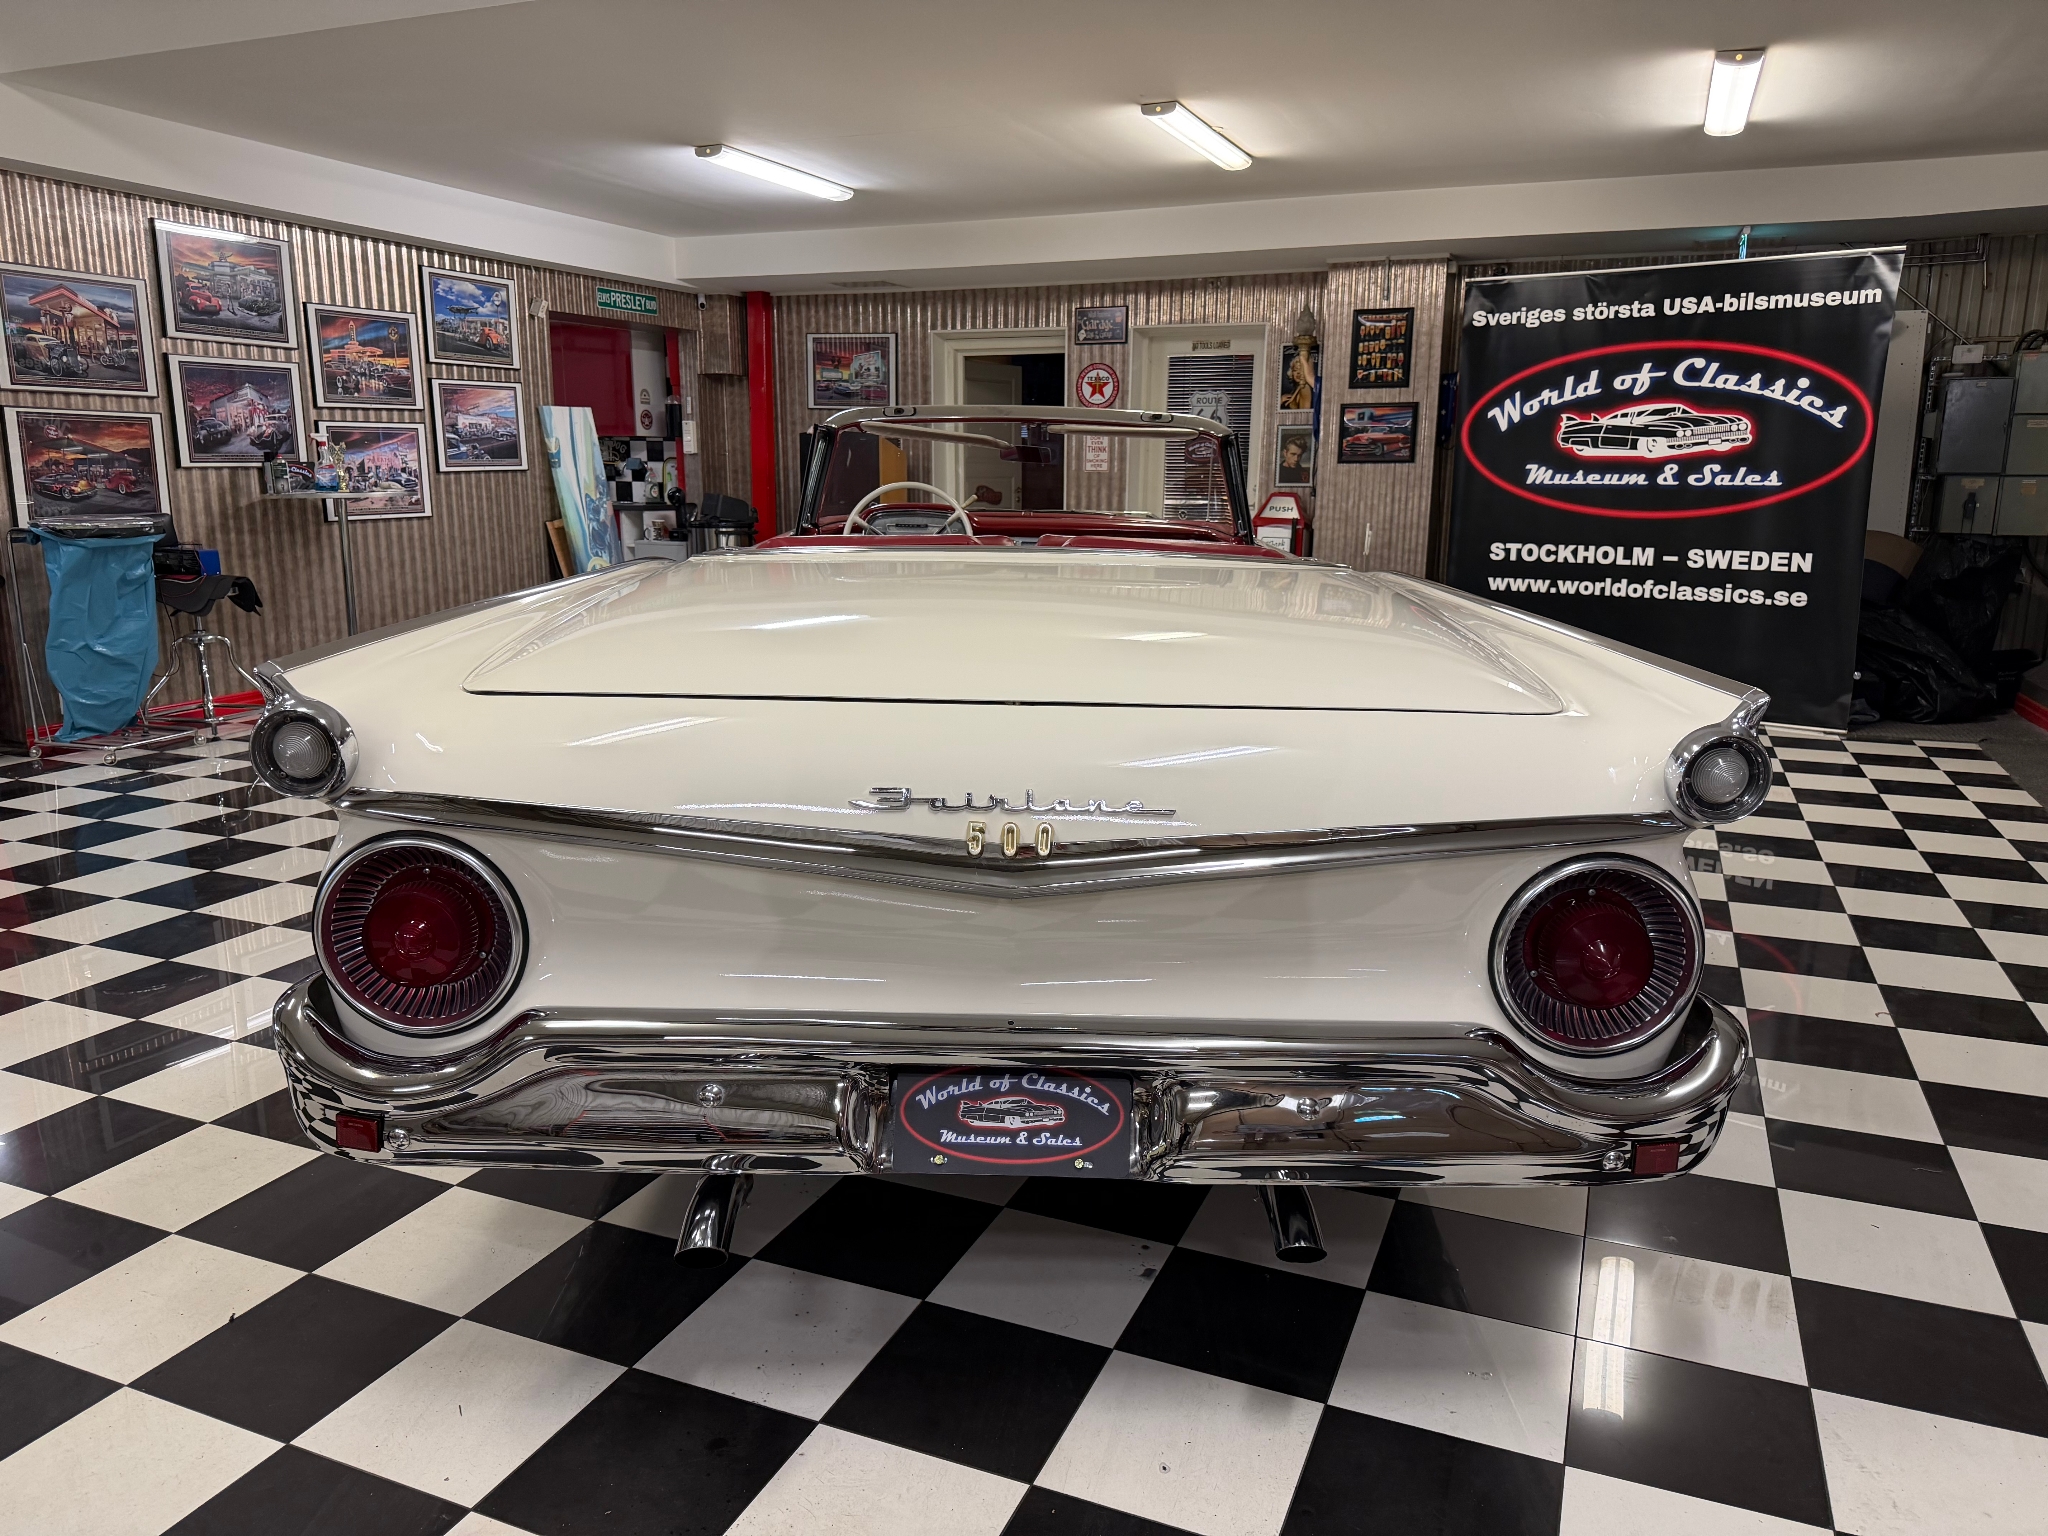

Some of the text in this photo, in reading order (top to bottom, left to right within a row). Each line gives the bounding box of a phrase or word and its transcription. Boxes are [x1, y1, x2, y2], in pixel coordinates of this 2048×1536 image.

[597, 291, 610, 303] ELVIS
[610, 292, 646, 310] PRESLEY
[1472, 287, 1882, 328] Sveriges största USA-bilsmuseum
[1487, 357, 1848, 433] World of Classics
[1525, 463, 1783, 487] Museum & Sales
[1489, 542, 1654, 566] STOCKHOLM
[1687, 549, 1813, 573] SWEDEN
[1488, 576, 1808, 607] www.worldofclassics.se
[848, 786, 1176, 816] Fairlane
[966, 820, 1055, 860] 500
[916, 1073, 1110, 1116] World of Classics
[939, 1129, 1083, 1146] Museum & Sales
